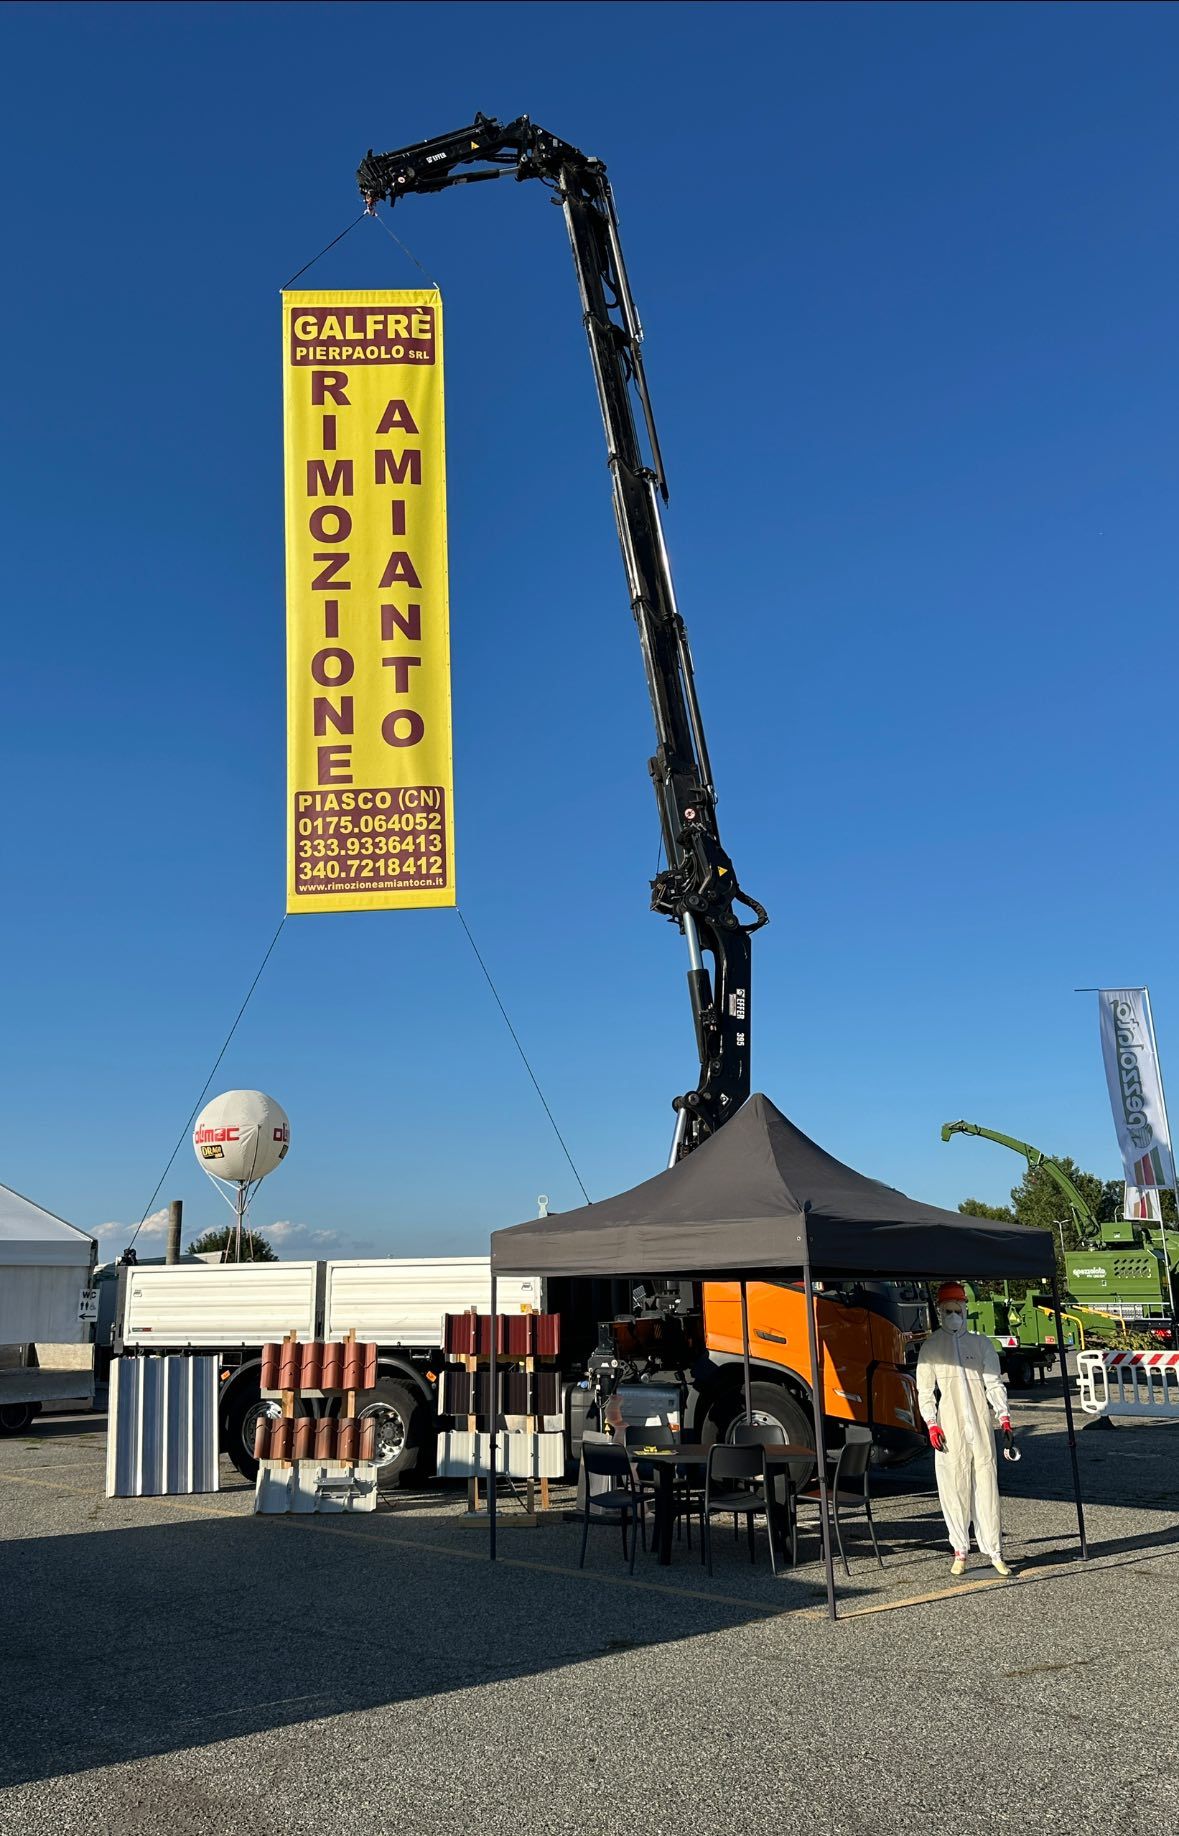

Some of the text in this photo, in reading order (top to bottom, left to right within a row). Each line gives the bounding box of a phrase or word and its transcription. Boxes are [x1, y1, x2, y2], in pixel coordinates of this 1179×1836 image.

[294, 308, 432, 341] GALFRÈ
[296, 345, 430, 360] PIERPAOLO SRL
[306, 370, 355, 786] RIMOZIONE
[374, 399, 425, 748] AMIANTO
[298, 788, 441, 812] PIASCO (CN)
[299, 813, 442, 836] 0175.064052
[299, 834, 442, 858] 333.9336413
[299, 856, 443, 880] 340.7218412
[299, 877, 444, 892] www.rimozioneamiantocn.it
[736, 998, 745, 1020] EFFER
[736, 1032, 745, 1047] 395
[83, 1291, 97, 1299] WC
